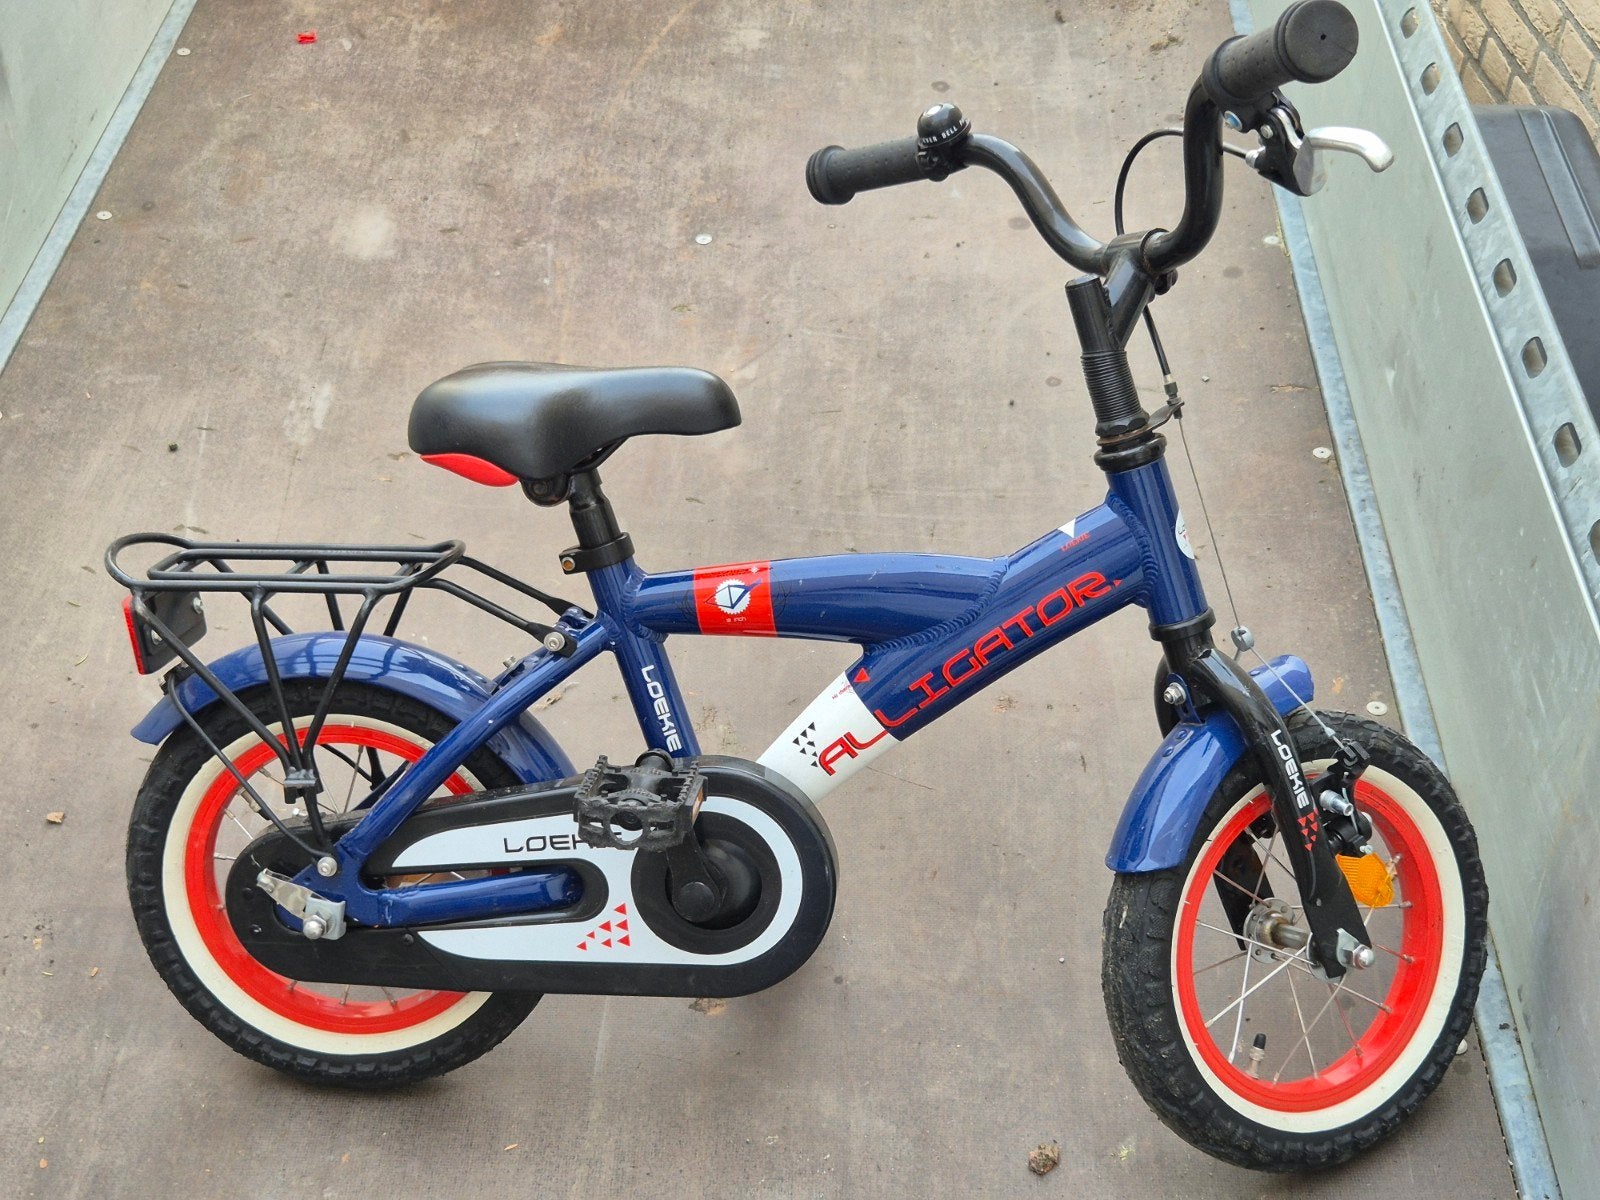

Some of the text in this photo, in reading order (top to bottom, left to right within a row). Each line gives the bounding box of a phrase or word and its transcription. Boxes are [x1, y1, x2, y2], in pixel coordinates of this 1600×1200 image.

[641, 664, 682, 753] LOEKIE
[818, 571, 1112, 777] ALLIGATOR
[1270, 729, 1310, 809] LOEKIE
[503, 831, 623, 853] LOEK
